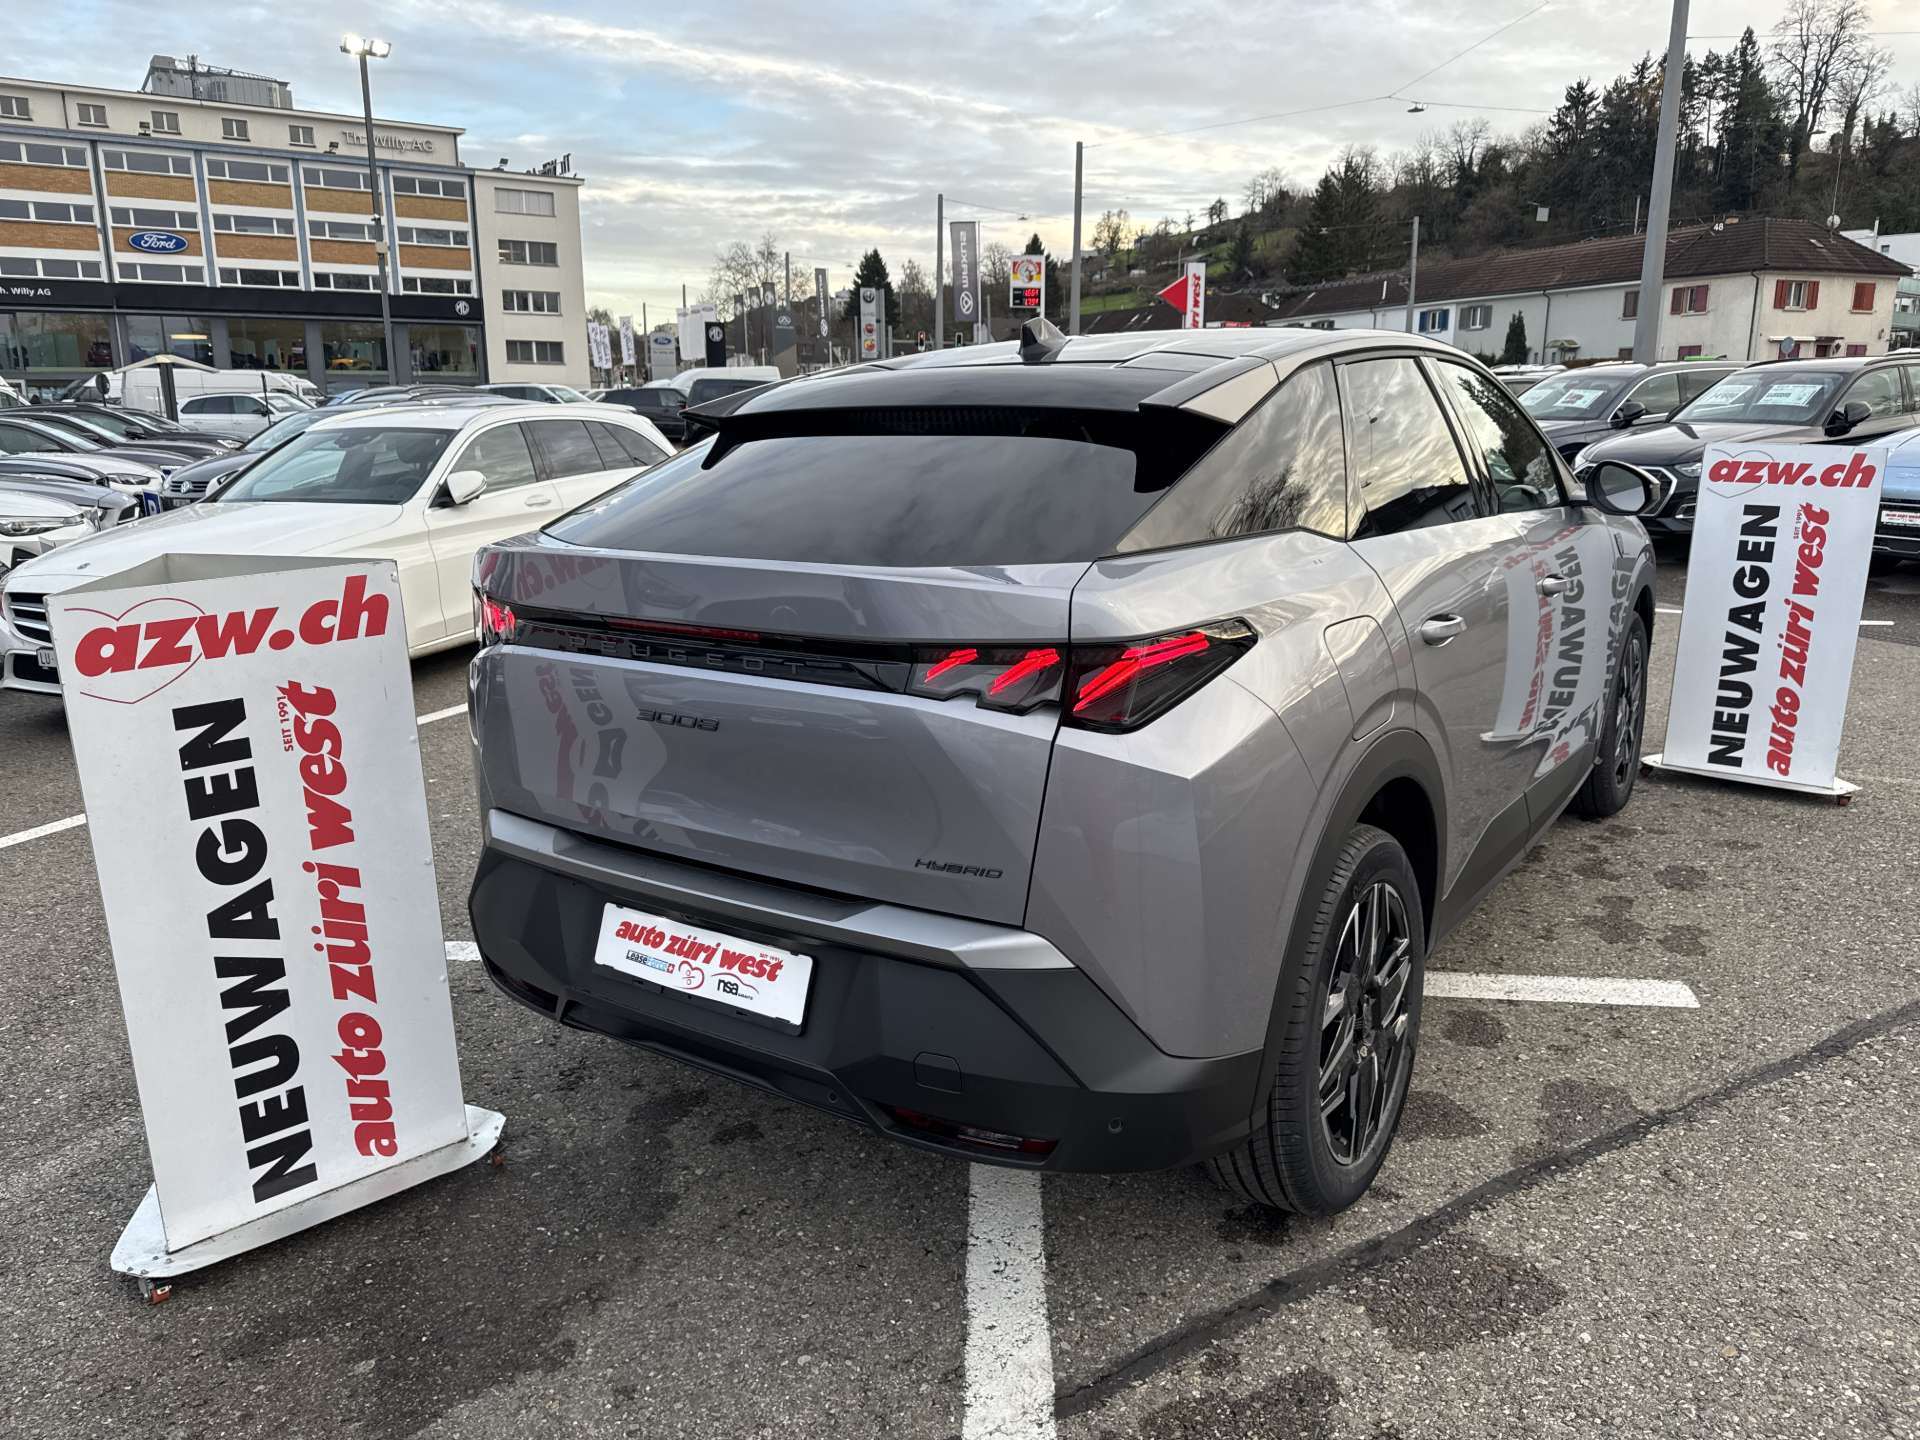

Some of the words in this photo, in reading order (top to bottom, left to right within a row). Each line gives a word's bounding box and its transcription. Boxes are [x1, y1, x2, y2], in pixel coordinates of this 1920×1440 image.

[374, 135, 406, 153] Willy
[412, 138, 433, 152] AG
[141, 232, 176, 249] Ford
[1713, 222, 1724, 231] 48
[11, 287, 35, 297] Willy
[37, 288, 52, 296] AG
[1708, 453, 1876, 488] azw.ch
[1792, 502, 1830, 596] west
[74, 574, 390, 678] azw.ch
[1707, 504, 1781, 768] NEUWAGEN
[1777, 597, 1815, 689] züri
[568, 635, 805, 675] PEUGEOT
[276, 695, 290, 724] 1991
[636, 707, 720, 732] 3008
[281, 728, 294, 752] SEIT
[1766, 686, 1801, 776] auto
[275, 679, 353, 852] west
[914, 858, 1004, 879] HYBRID
[172, 697, 318, 1204] NEUWAGEN
[302, 860, 378, 1004] züri
[615, 920, 666, 949] auto
[664, 934, 721, 964] züri
[719, 949, 785, 982] west
[716, 978, 739, 996] nsa
[330, 1011, 398, 1158] auto
